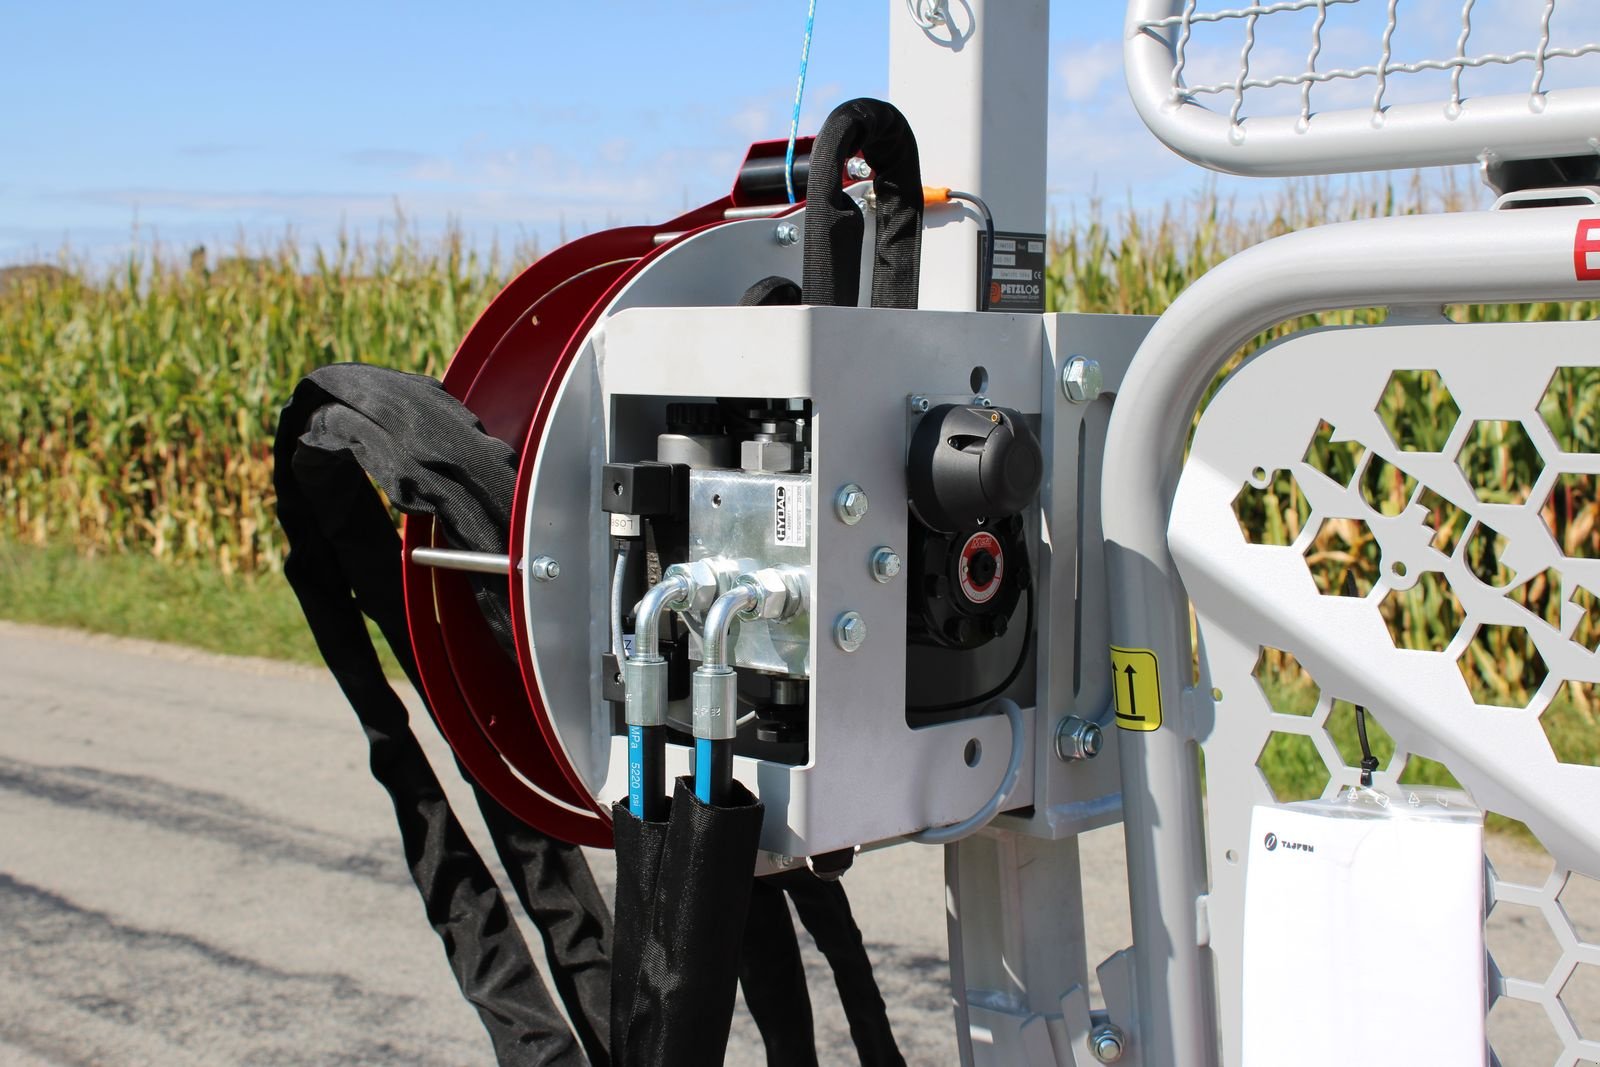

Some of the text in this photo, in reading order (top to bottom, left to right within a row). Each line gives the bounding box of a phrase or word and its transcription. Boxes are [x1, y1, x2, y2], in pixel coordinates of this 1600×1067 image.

[1001, 284, 1040, 294] PETZLOG
[776, 488, 785, 539] HYDAC
[631, 726, 641, 807] MPa 5220 psi
[1281, 840, 1314, 853] TAJFUN
